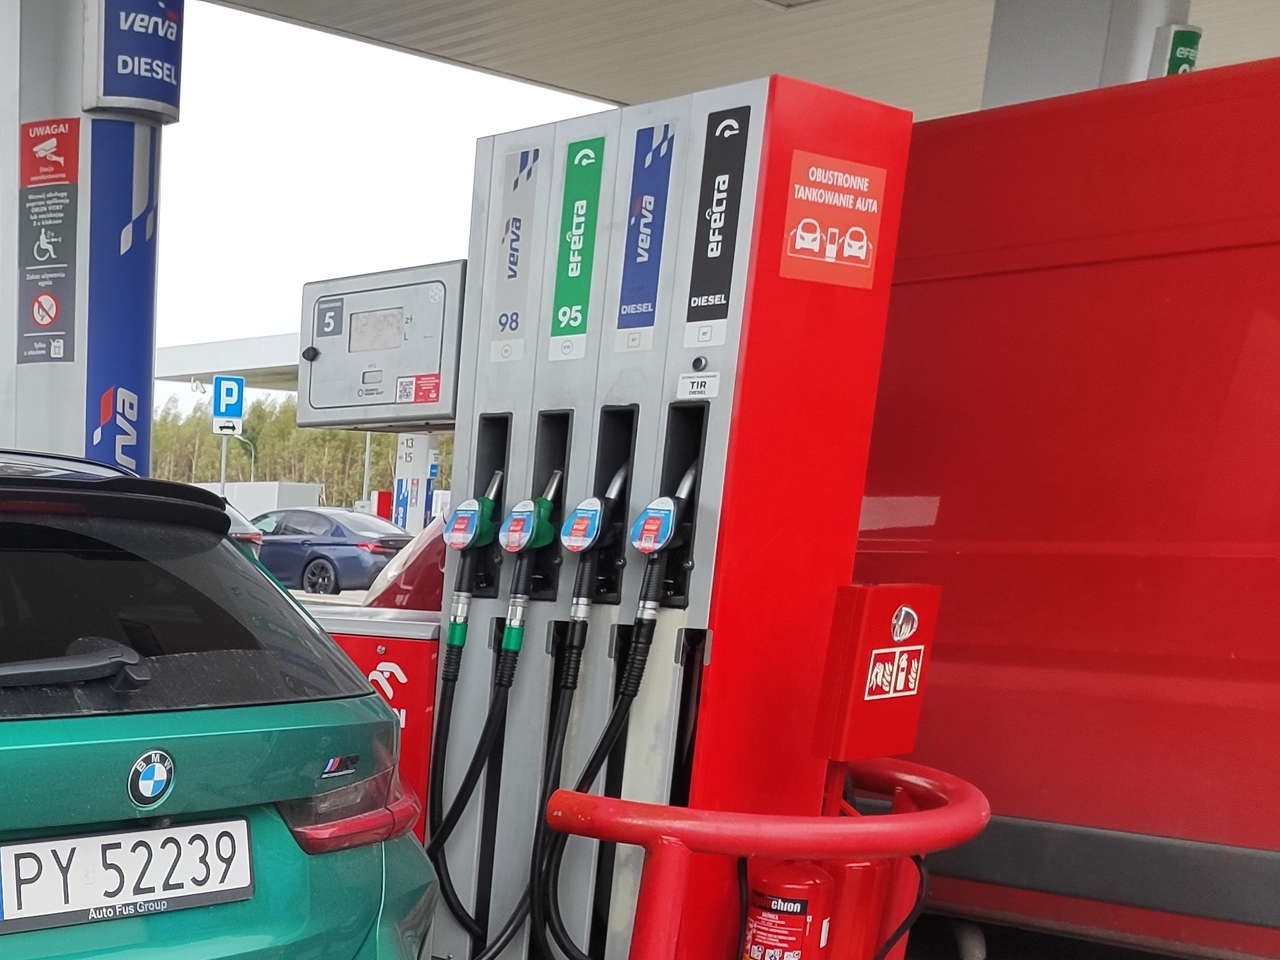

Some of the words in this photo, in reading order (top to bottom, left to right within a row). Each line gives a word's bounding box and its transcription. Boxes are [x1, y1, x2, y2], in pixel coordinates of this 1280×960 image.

[119, 11, 178, 41] verva
[117, 54, 177, 86] DIESEL
[29, 123, 69, 138] UWAGA!
[808, 166, 870, 192] OBUSTRONNE
[794, 184, 855, 209] TANKOWANIE
[855, 196, 878, 214] AUTA
[706, 174, 730, 259] efecta
[567, 200, 587, 278] efecta
[636, 195, 655, 263] verva
[507, 217, 522, 280] verva
[620, 302, 654, 315] DIESEL
[690, 294, 727, 308] DIESEL
[323, 311, 335, 333] 5
[498, 311, 519, 333] 98
[558, 305, 583, 328] 95
[220, 380, 239, 413] P
[689, 380, 707, 390] TIR
[115, 387, 139, 471] rva
[405, 438, 414, 449] 13
[404, 452, 413, 463] 15
[136, 753, 172, 773] BMW
[13, 846, 77, 911] PY
[100, 830, 237, 899] 52239
[88, 907, 114, 920] Auto
[115, 904, 135, 916] Fus
[136, 900, 168, 913] Group
